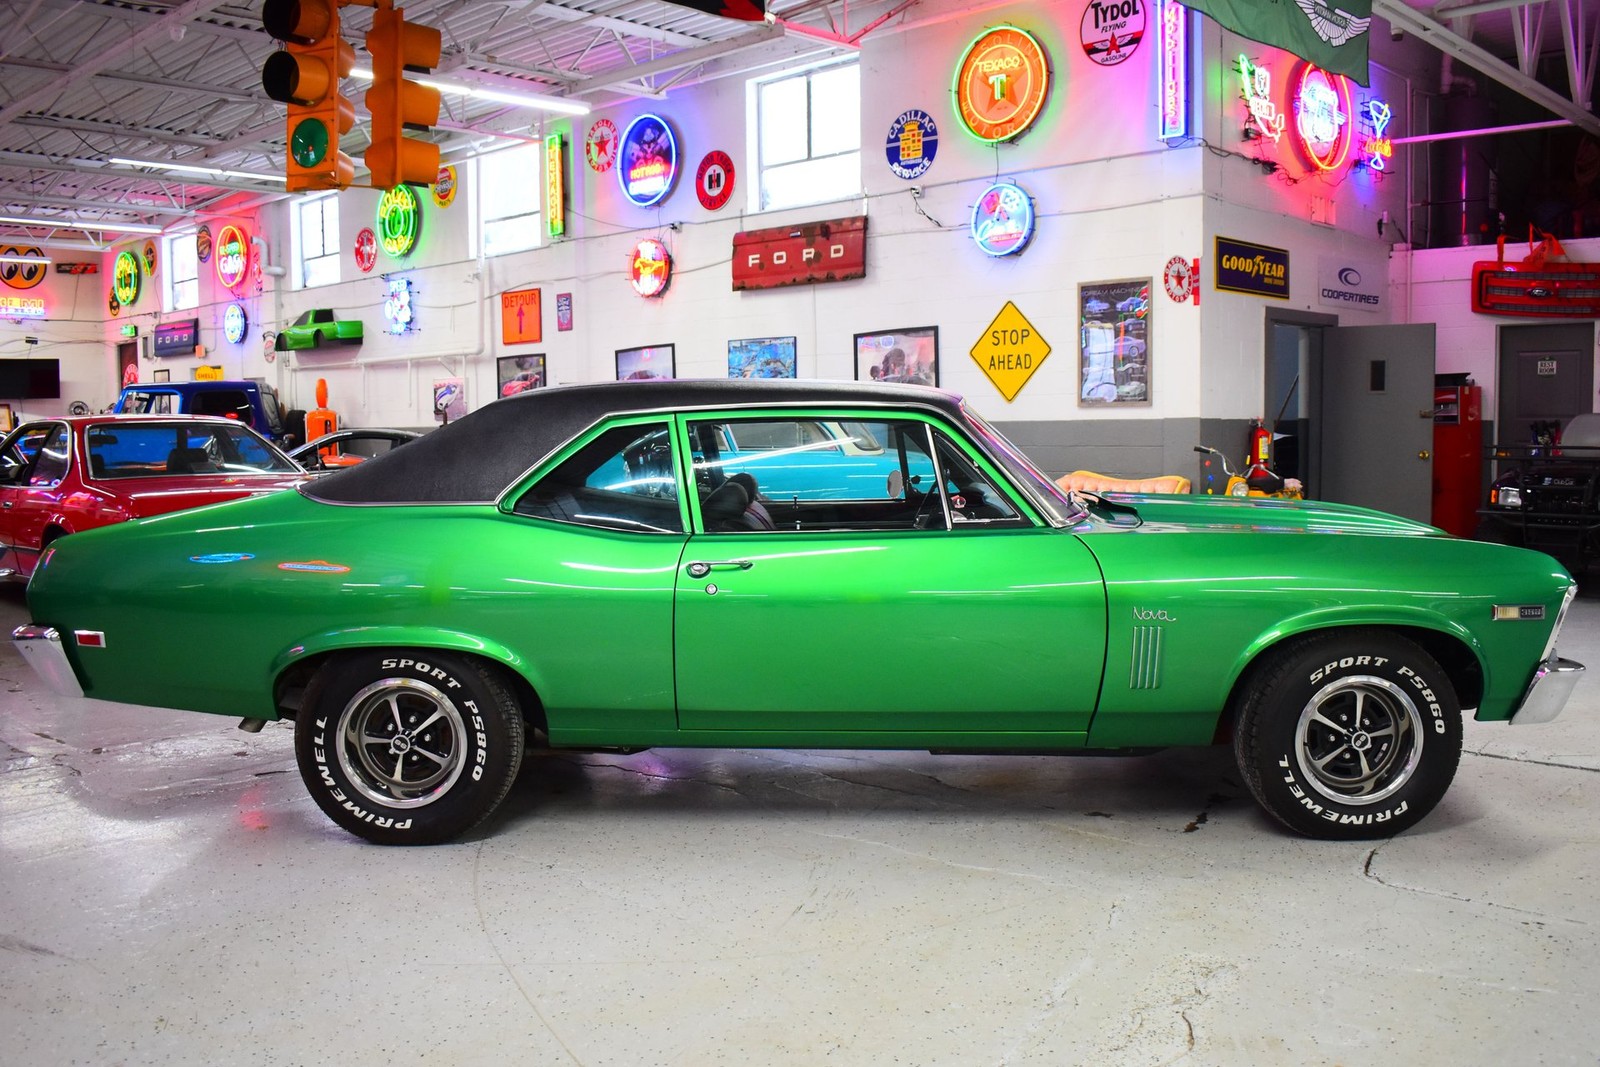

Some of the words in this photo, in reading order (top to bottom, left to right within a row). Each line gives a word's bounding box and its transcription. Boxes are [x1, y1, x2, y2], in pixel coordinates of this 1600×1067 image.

[1091, 0, 1140, 29] TYDOL
[1101, 21, 1127, 33] FLYING
[976, 56, 1020, 72] TEXACO
[1101, 53, 1127, 63] GASOLINE
[889, 111, 935, 139] CADILLAC
[963, 101, 1015, 138] MOTOR
[888, 157, 932, 179] SERVICE
[748, 244, 844, 267] FORD
[1222, 254, 1285, 278] GOODYEAR
[503, 294, 537, 308] DETOUR
[158, 334, 188, 345] FORD
[992, 329, 1030, 346] STOP
[989, 353, 1032, 371] AHEAD
[1133, 606, 1177, 622] Nova
[381, 658, 462, 690] SPORT
[1309, 655, 1389, 685] SPORT
[1397, 666, 1446, 735] PS860
[463, 700, 488, 782] PS860
[313, 715, 413, 830] PRIMEWELL
[1278, 754, 1410, 826] PRIMEWELL
